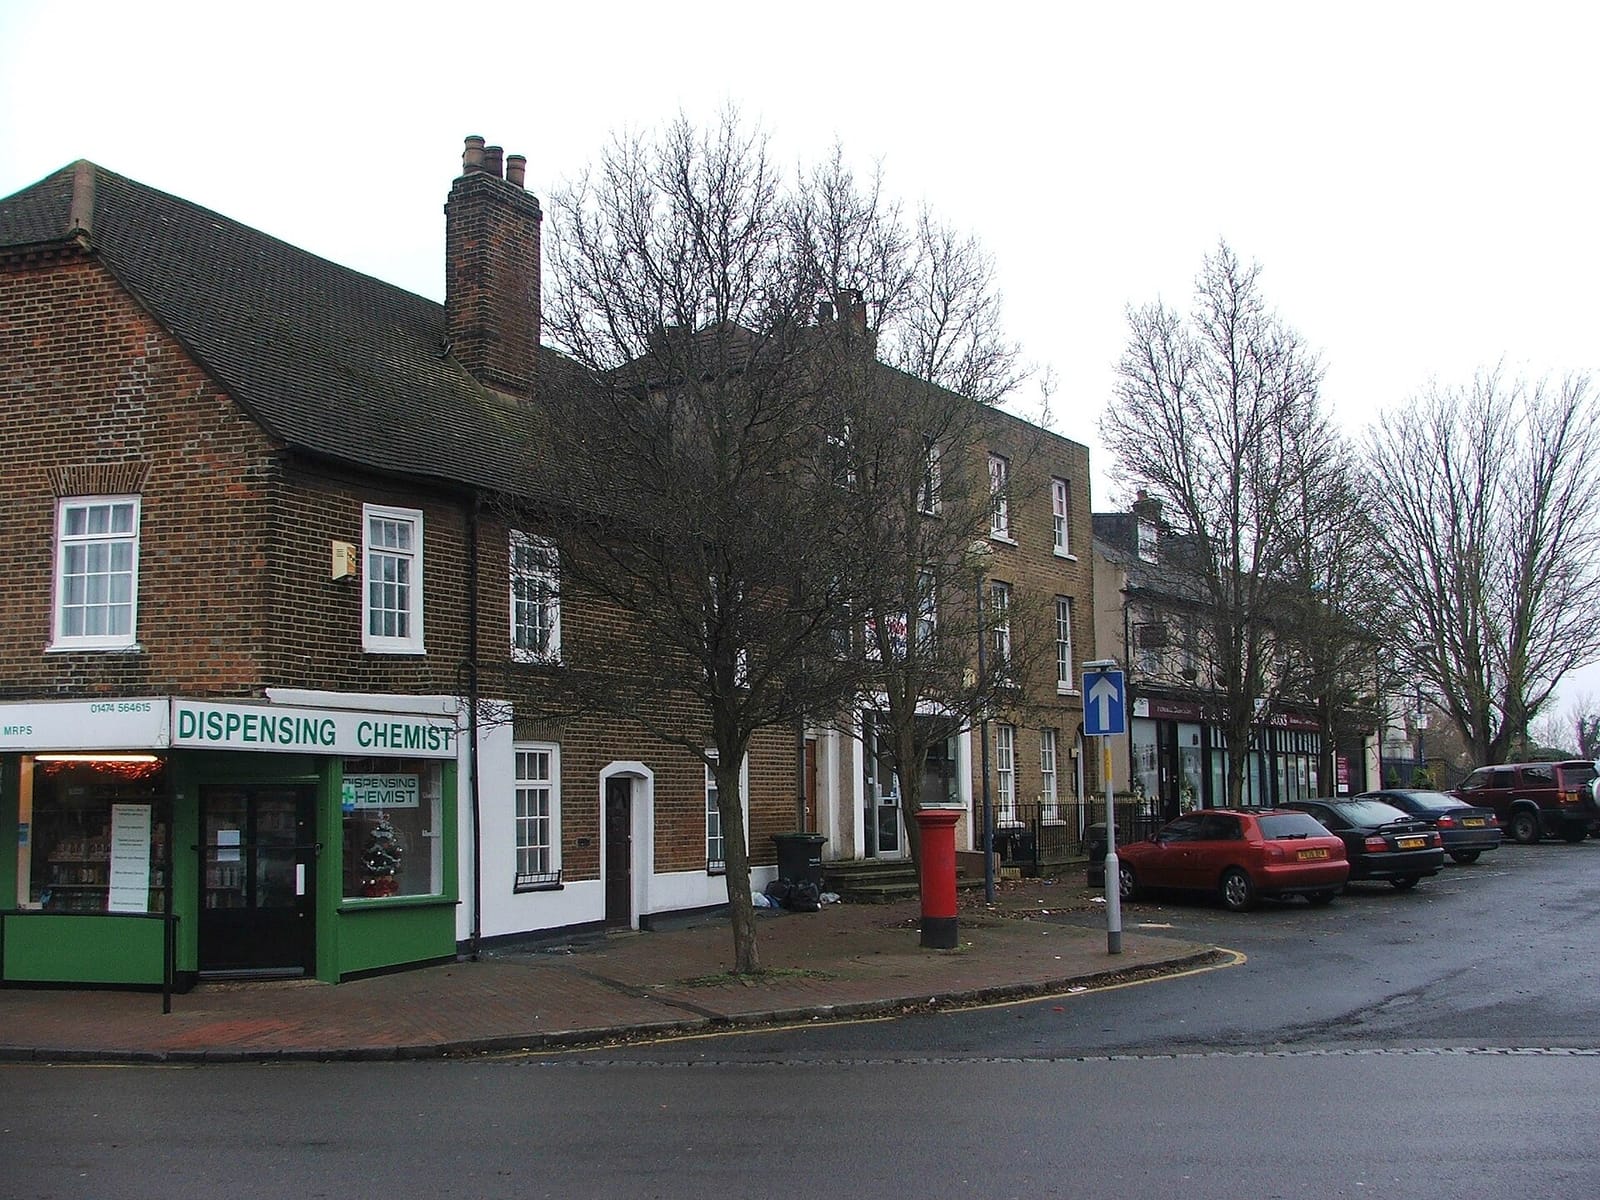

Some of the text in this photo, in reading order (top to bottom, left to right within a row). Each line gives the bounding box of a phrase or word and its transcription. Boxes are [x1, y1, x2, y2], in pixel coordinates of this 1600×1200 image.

[90, 702, 151, 713] 01474 564615
[3, 725, 33, 736] MRPS
[178, 709, 453, 751] DISPENSING CHEMIST
[355, 790, 416, 804] HEMIST
